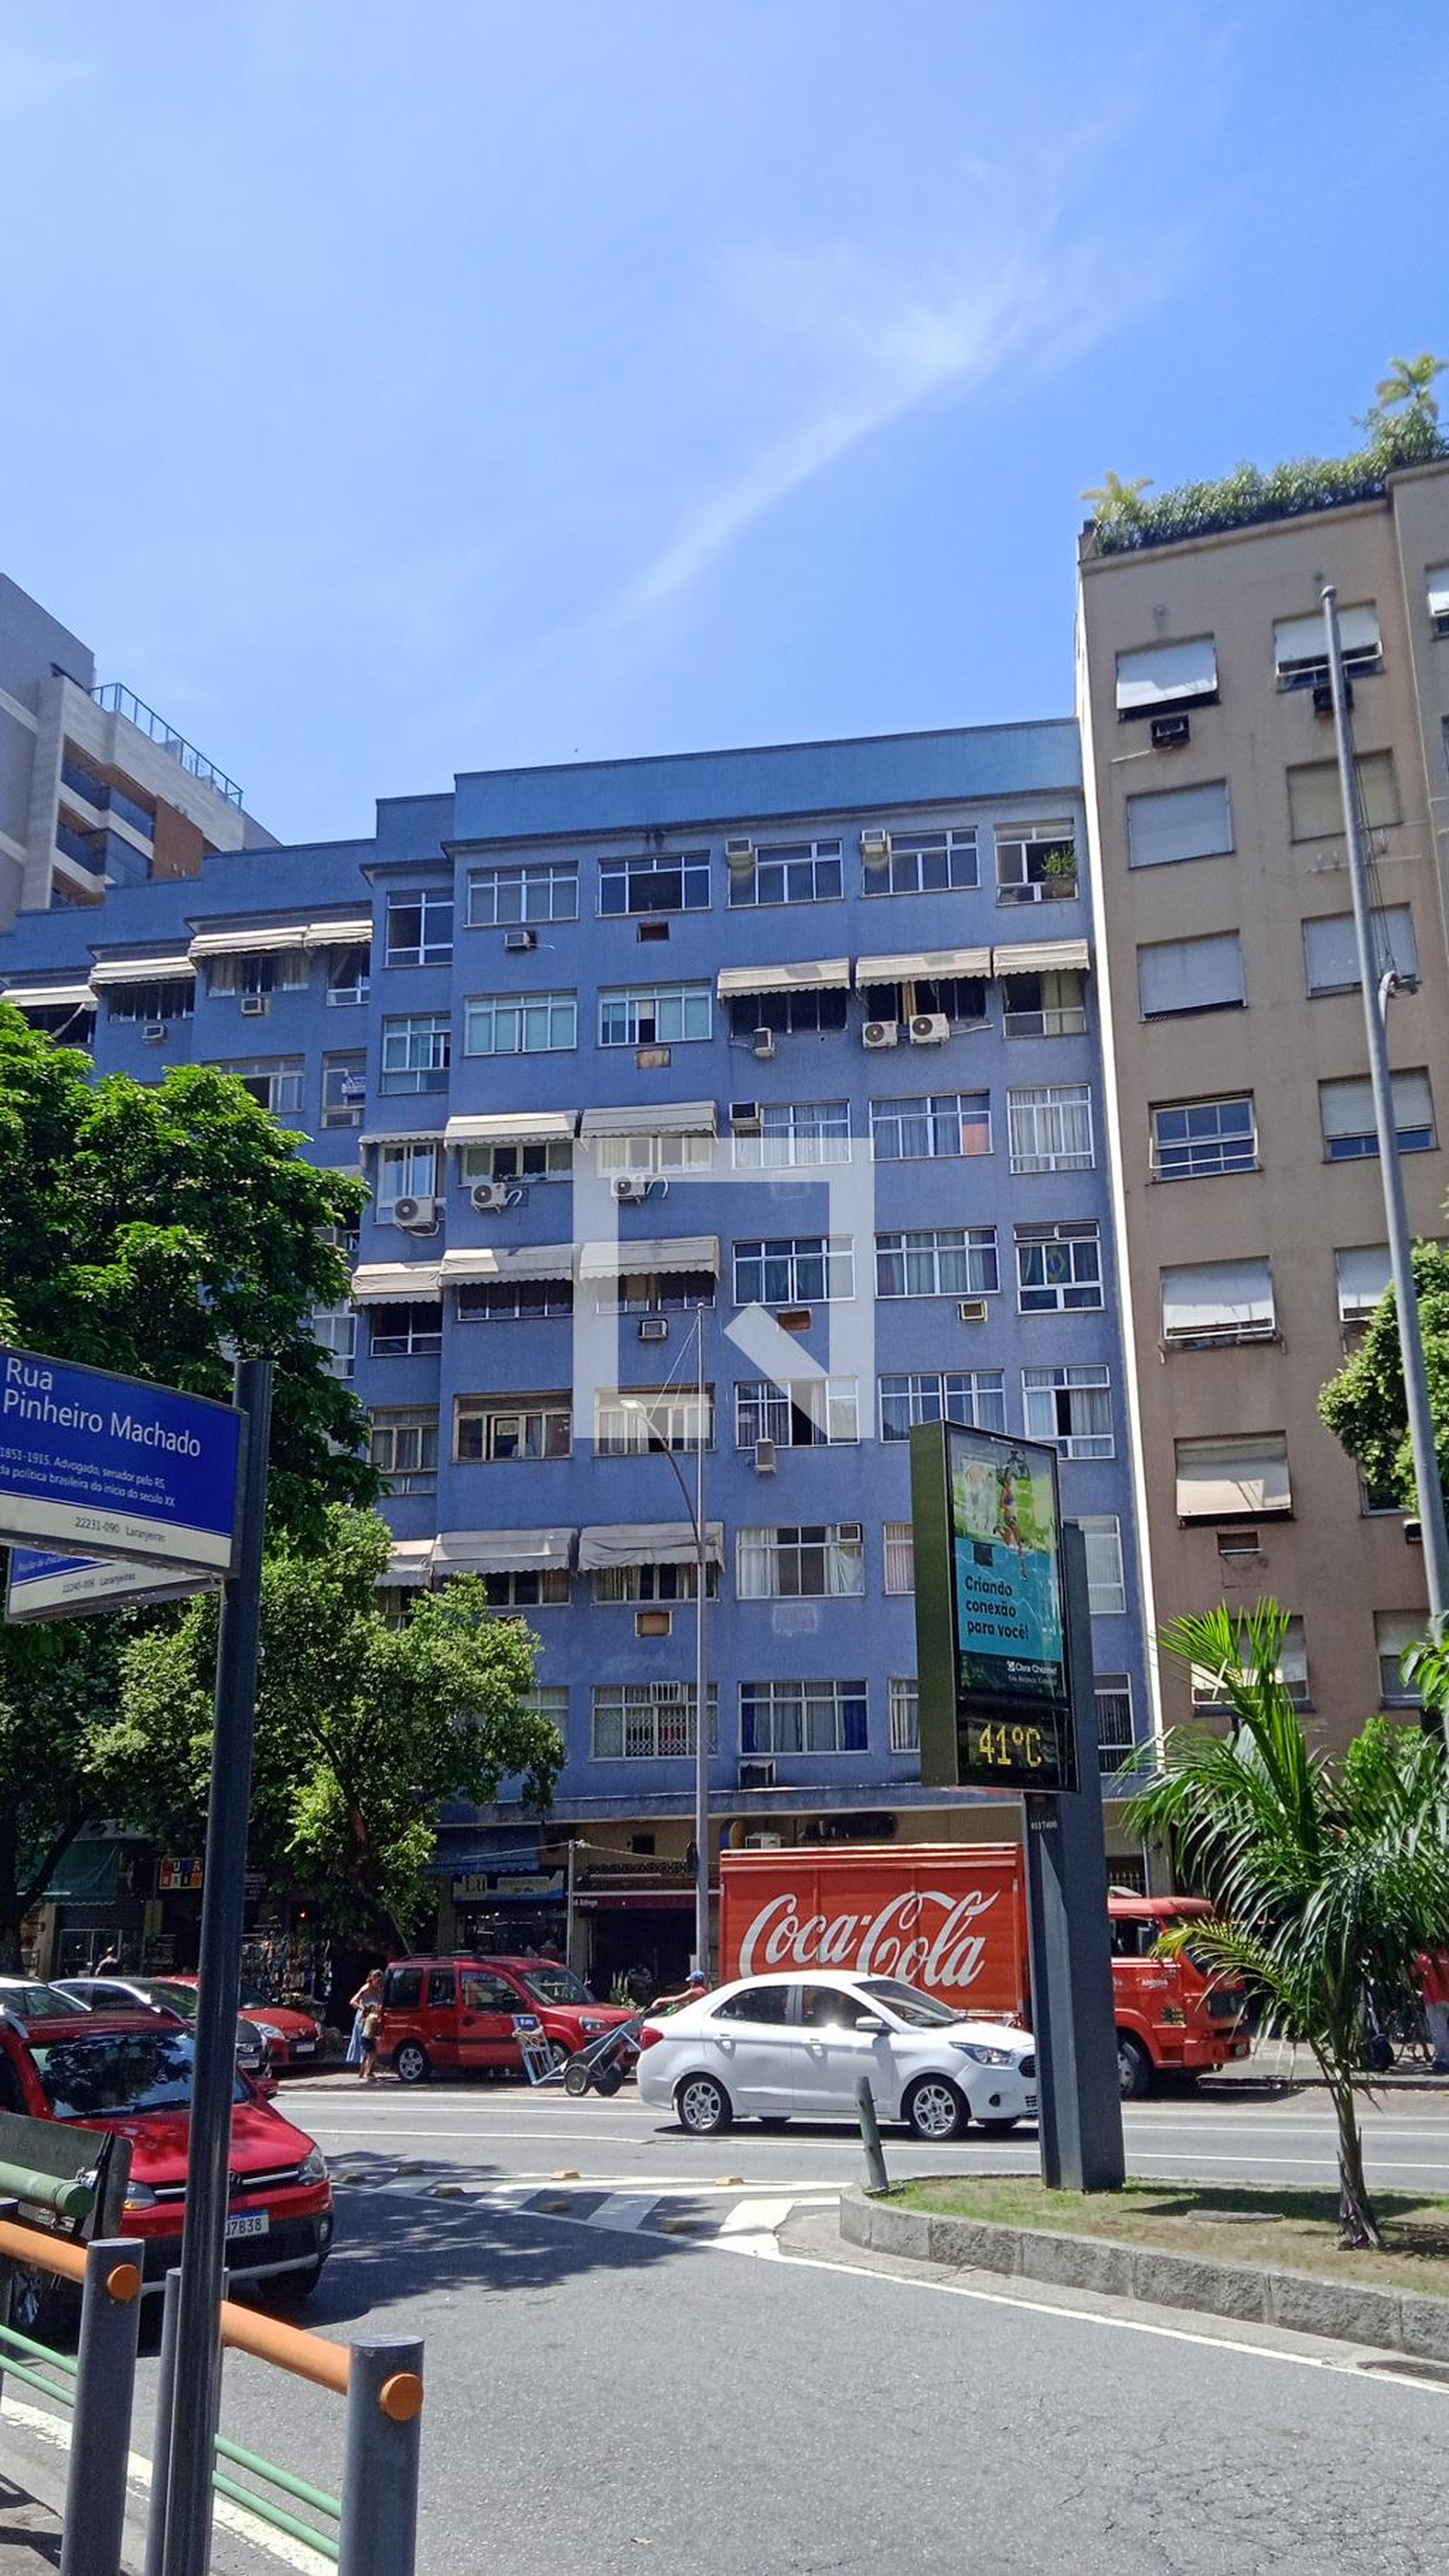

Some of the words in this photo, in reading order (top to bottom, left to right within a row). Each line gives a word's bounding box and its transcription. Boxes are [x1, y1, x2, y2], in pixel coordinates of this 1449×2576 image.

[6, 1357, 52, 1390] Rua
[3, 1389, 103, 1432] Pinheiro
[111, 1412, 201, 1457] Machado
[90, 1481, 102, 1492] do
[127, 1488, 138, 1499] do
[75, 1517, 120, 1534] 22231-090
[966, 1600, 1016, 1618] conexão
[968, 1621, 995, 1636] para
[998, 1624, 1029, 1640] você!
[739, 1890, 1000, 1987] Coca-Cola
